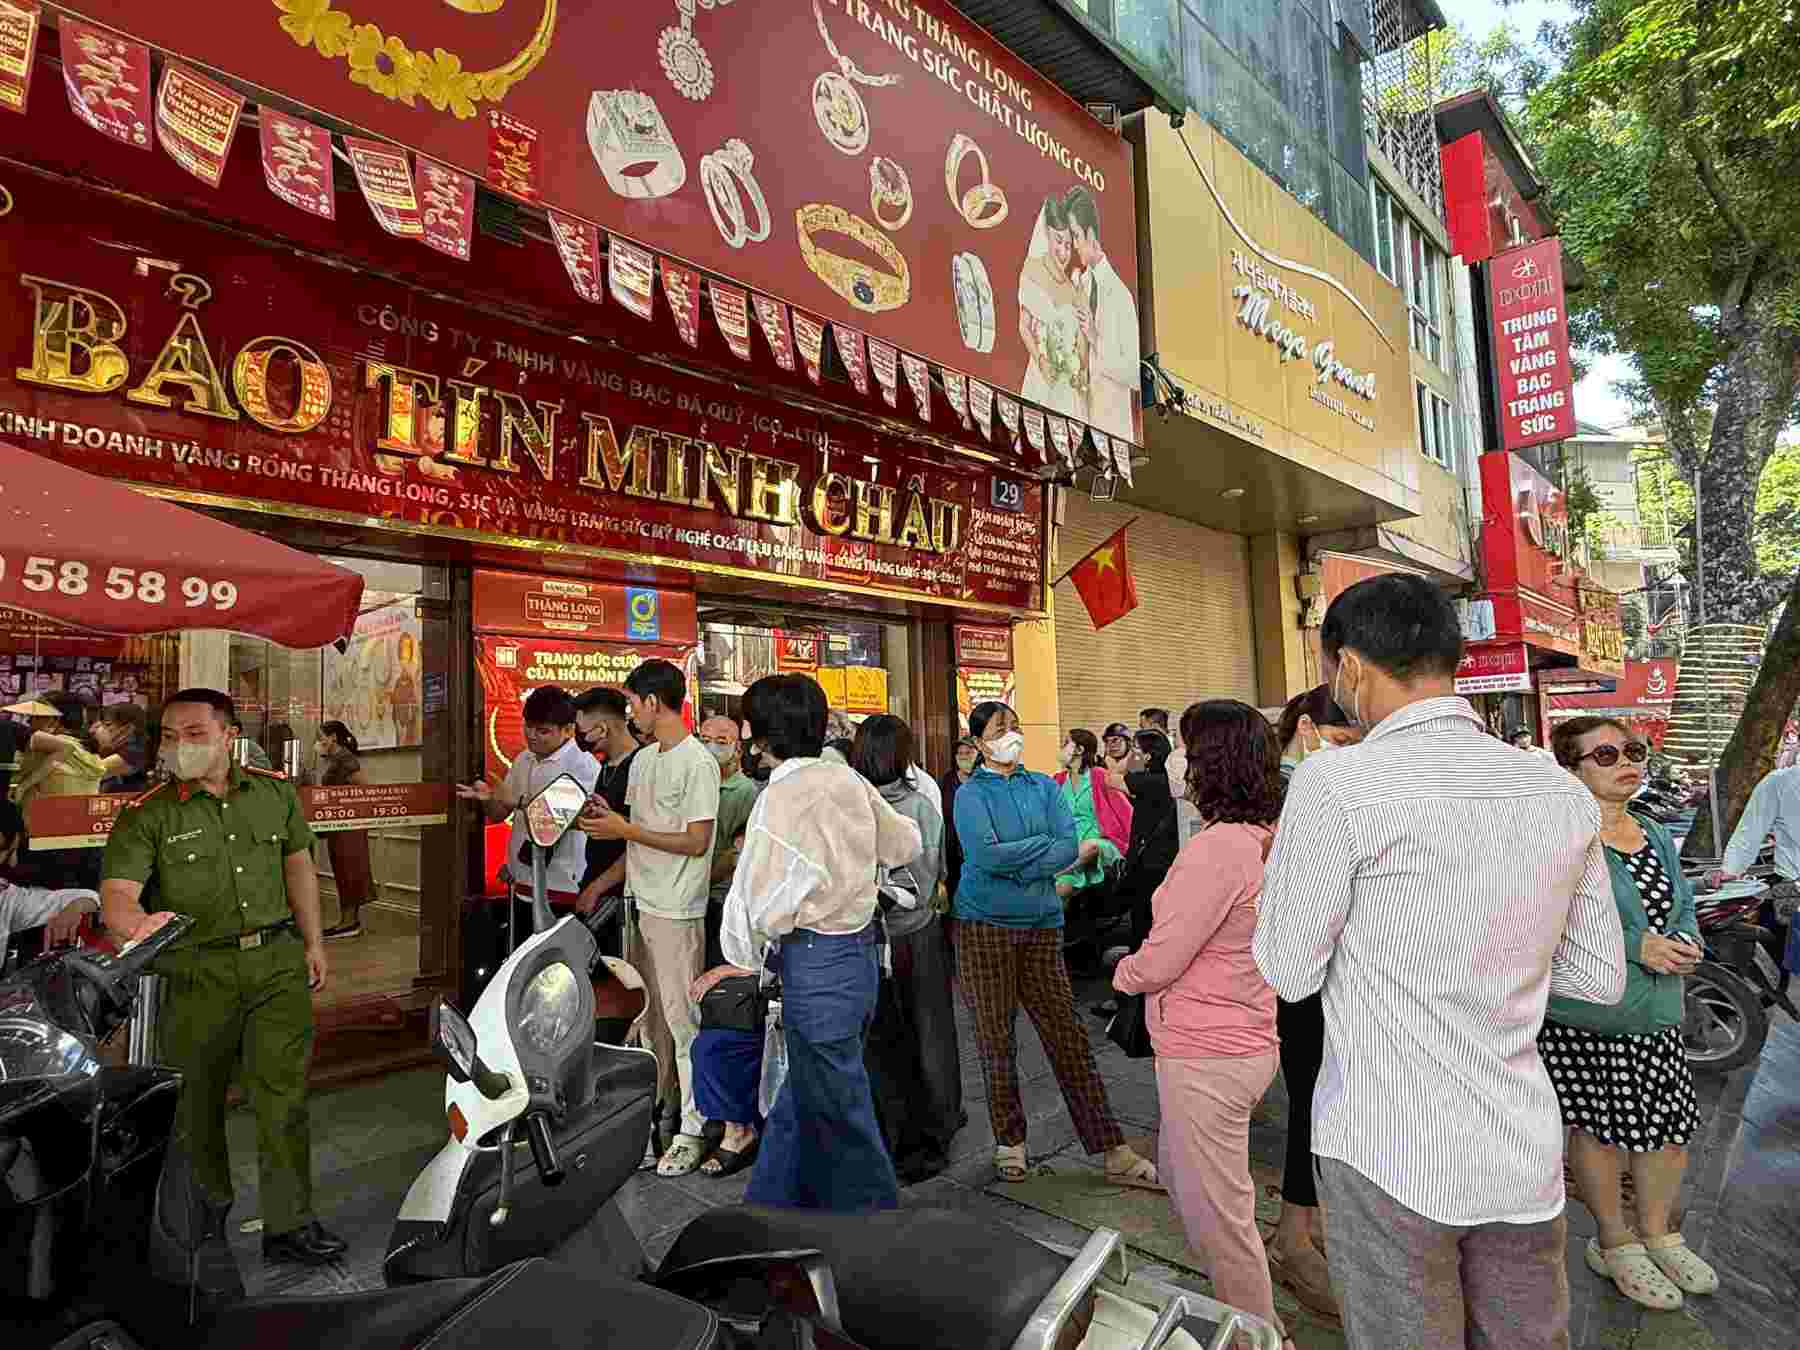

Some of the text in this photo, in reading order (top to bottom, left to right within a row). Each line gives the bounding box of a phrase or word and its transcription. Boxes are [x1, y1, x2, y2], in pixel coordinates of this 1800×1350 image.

[913, 5, 981, 73] THĂNG
[984, 60, 1032, 112] LONG
[845, 0, 1105, 191] TRANG SỨC CHẤT LƯỢNG CAO
[1502, 307, 1558, 335] TRUNG
[1512, 330, 1550, 354] TÂM
[357, 304, 439, 342] CÔNG
[448, 327, 481, 353] TY
[495, 341, 554, 375] TNHH
[563, 358, 624, 392] VÀNG
[629, 379, 672, 406] BẠC
[1510, 350, 1557, 375] VÀNG
[1517, 372, 1552, 395] BẠC
[15, 272, 963, 554] BẢO TÍN MINH CHÂU
[1508, 391, 1564, 417] TRANG
[1521, 415, 1555, 436] SỨC
[63, 422, 163, 459] DOANH
[170, 440, 241, 471] VÀNG
[246, 453, 313, 483] RỒNG
[319, 466, 391, 496] THĂNG
[396, 480, 454, 508] LONG,
[459, 492, 491, 513] SJC
[497, 496, 517, 516] VÀ
[523, 501, 567, 523] VÀNG
[570, 511, 620, 533] TRANG
[676, 527, 711, 547] NGHỆ
[999, 480, 1019, 505] 29
[22, 555, 89, 596] 58
[105, 566, 166, 604] 58
[181, 576, 238, 610] 99
[571, 602, 601, 616] LONG
[526, 664, 557, 681] CỦA
[314, 809, 355, 820] 09:00
